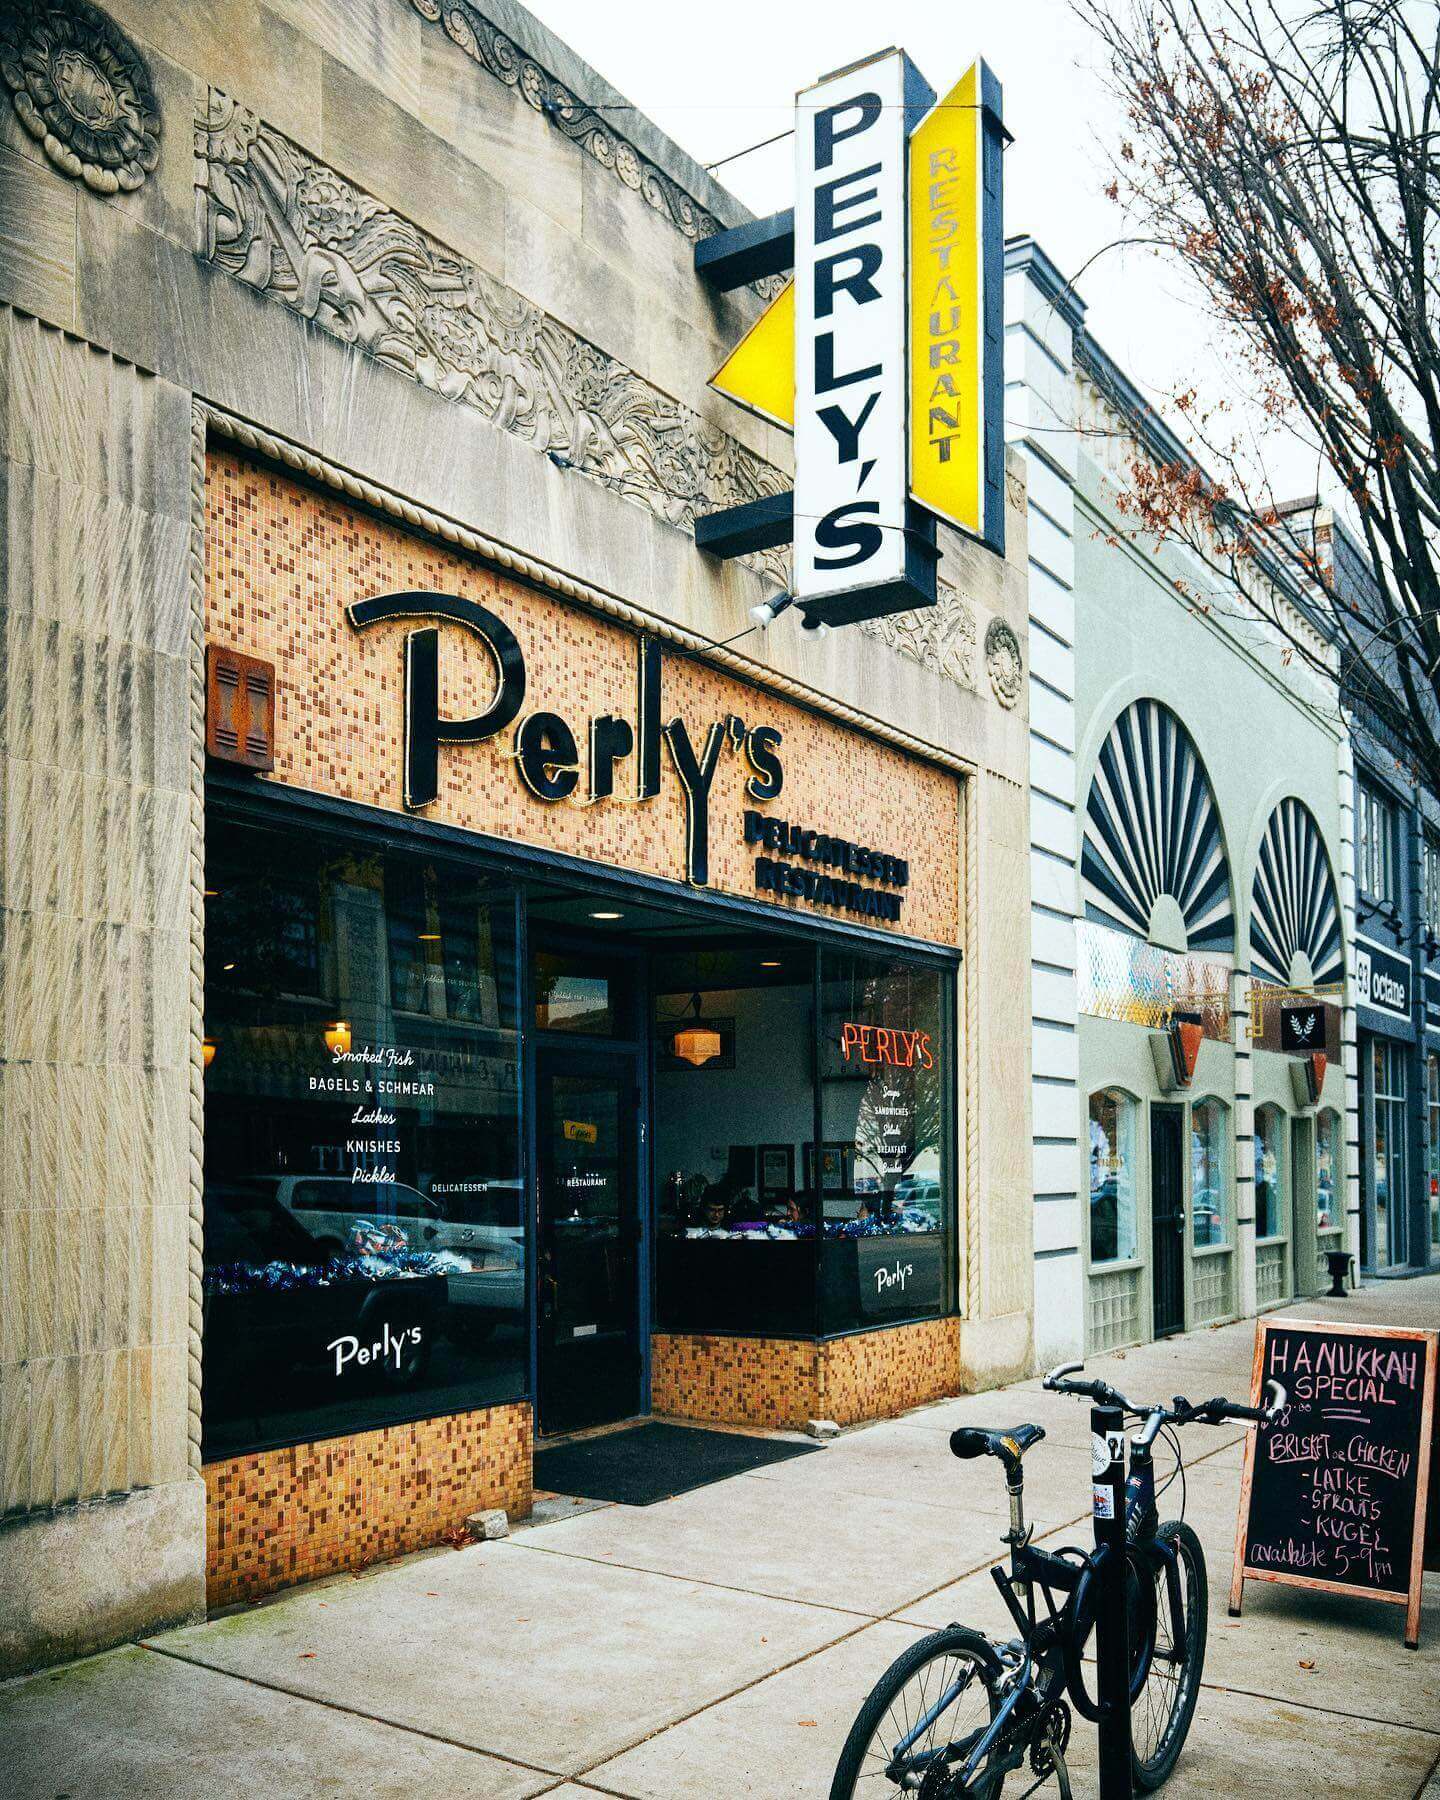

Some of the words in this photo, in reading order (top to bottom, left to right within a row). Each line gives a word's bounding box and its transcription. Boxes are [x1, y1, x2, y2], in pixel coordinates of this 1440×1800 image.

[927, 147, 961, 465] RESTAURANT
[813, 90, 884, 571] PERLY'S
[345, 591, 784, 887] Perly's
[744, 810, 909, 887] DELICATESSEN
[755, 857, 905, 921] RESTAURANT
[1372, 971, 1405, 1009] octane
[332, 1044, 384, 1063] Smoked
[385, 1048, 415, 1068] Fish
[843, 1022, 933, 1070] PERLY'S
[309, 1077, 360, 1092] BAGELS
[365, 1080, 373, 1093] &
[378, 1081, 435, 1095] SCHMEAR
[351, 1105, 397, 1125] Latkes
[874, 1106, 909, 1116] SANDWICHES
[346, 1140, 401, 1153] KNISHES
[877, 1145, 907, 1154] BREAKFAST
[351, 1165, 396, 1184] Pickles
[432, 1183, 488, 1192] DELICATESSEN
[566, 1178, 607, 1187] RESTAURANT
[874, 1260, 913, 1293] Perly's
[327, 1322, 423, 1377] Perly's
[1269, 1338, 1417, 1390] HANUKKAH
[1294, 1375, 1397, 1405] SPECIAL
[1269, 1433, 1331, 1461] BRISKET
[1347, 1434, 1411, 1477] CHICKEN
